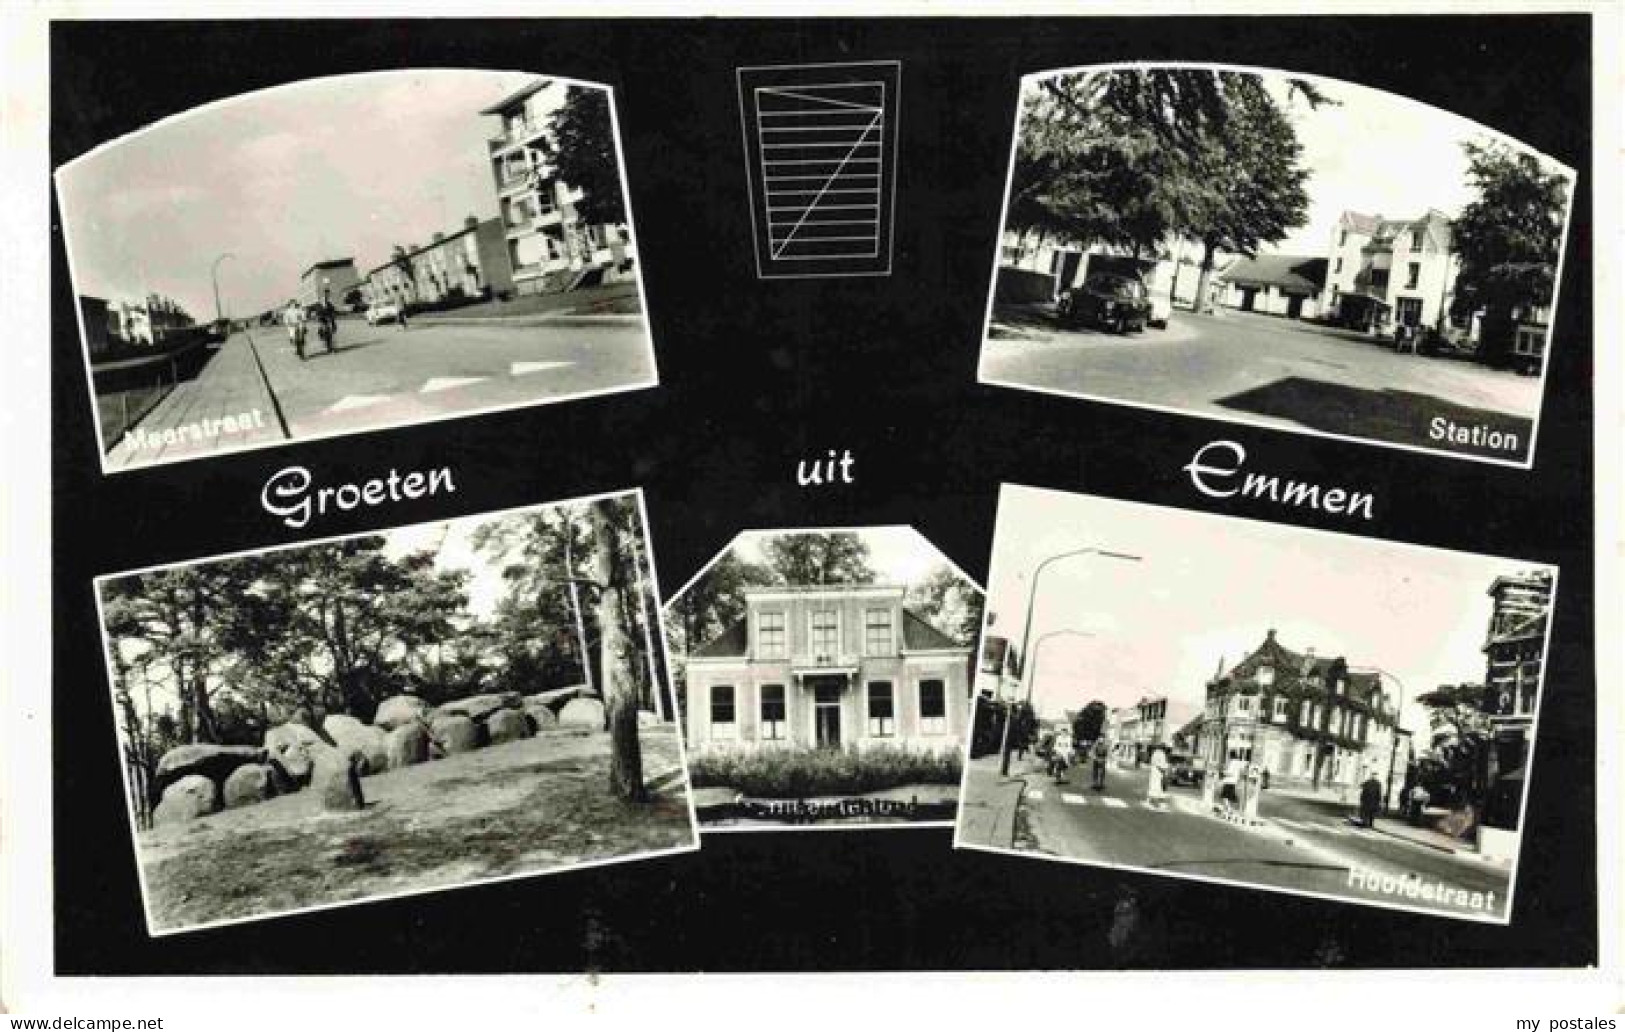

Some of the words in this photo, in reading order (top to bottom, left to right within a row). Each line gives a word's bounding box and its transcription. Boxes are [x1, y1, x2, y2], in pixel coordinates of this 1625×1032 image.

[1429, 416, 1518, 451] Station
[262, 466, 456, 527] Groeten
[797, 449, 855, 486] uit
[1184, 440, 1375, 520] Emmen
[1348, 861, 1496, 910] Hoofdstraat
